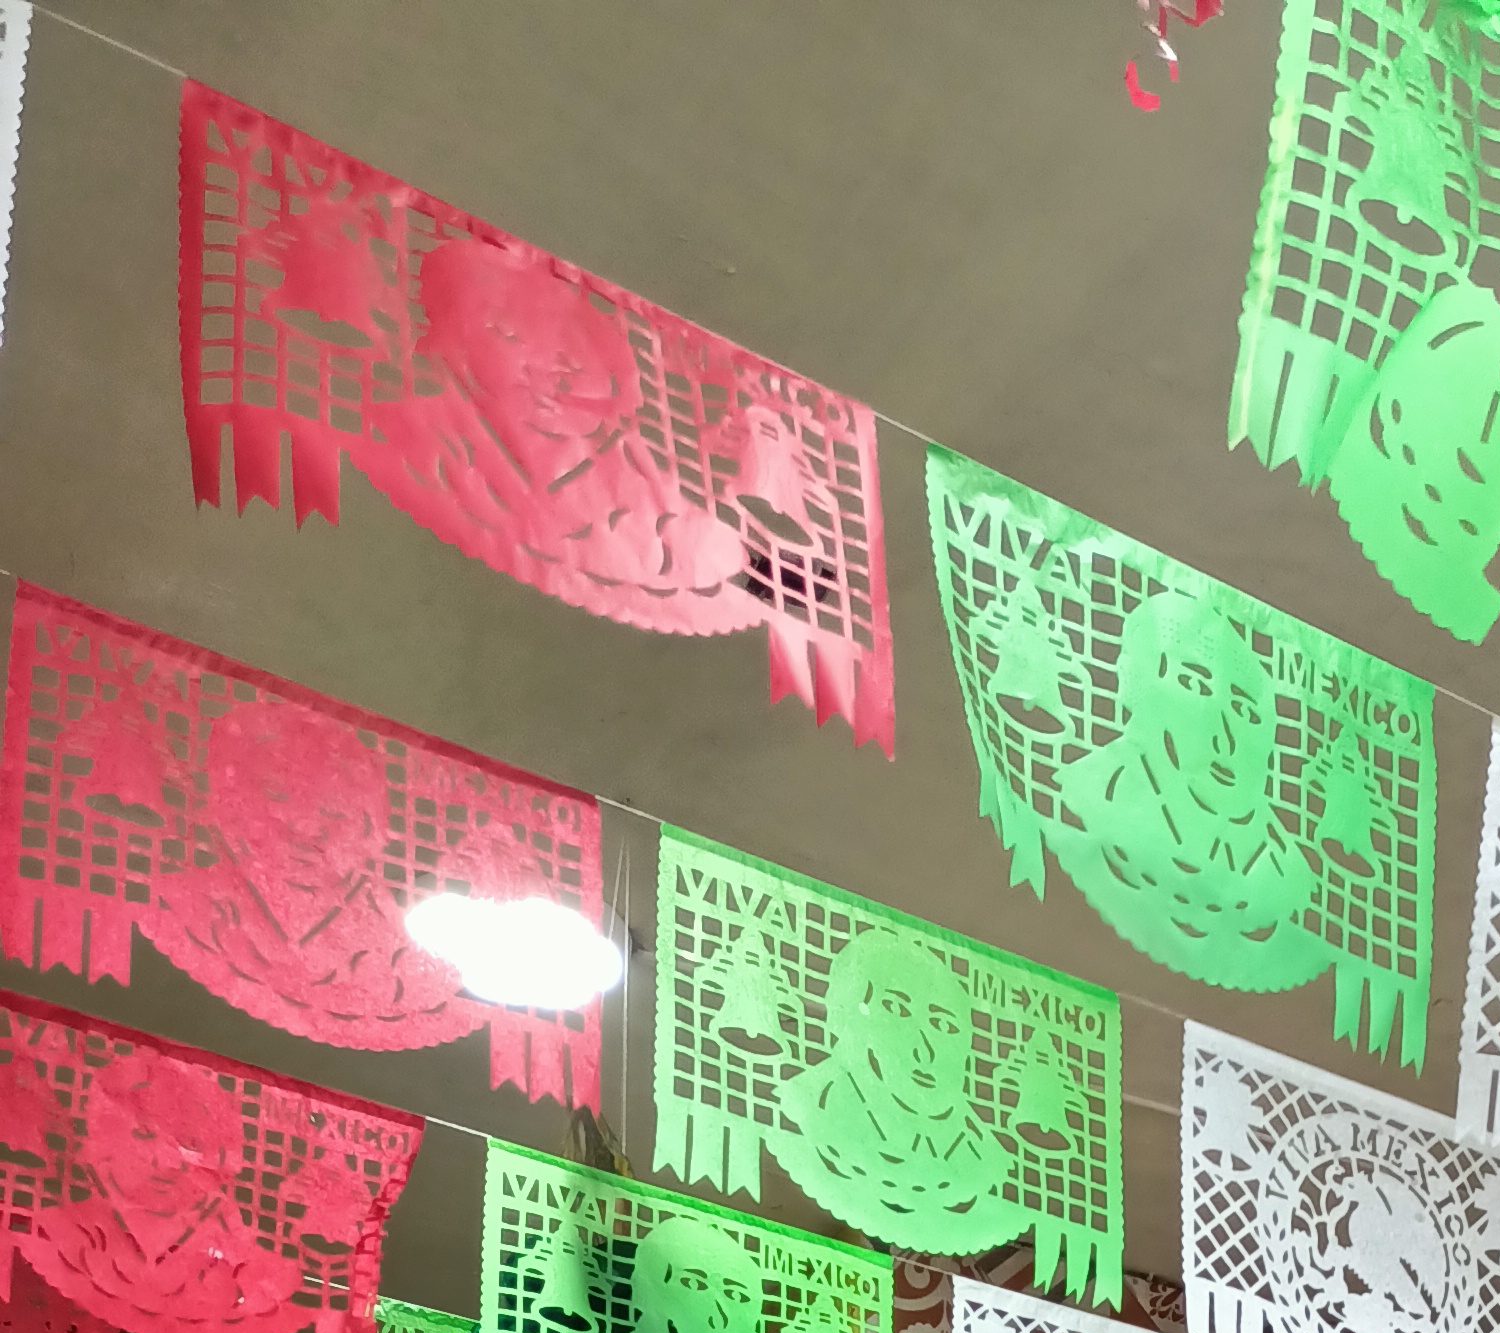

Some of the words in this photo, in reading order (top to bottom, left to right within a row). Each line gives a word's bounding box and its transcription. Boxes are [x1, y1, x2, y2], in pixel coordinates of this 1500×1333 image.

[942, 494, 1092, 600] VIVA
[1279, 648, 1418, 745] MEXICO
[676, 864, 797, 933] VIVA
[975, 969, 1104, 1040] MEXICO
[503, 1172, 607, 1226] VIVA
[765, 1245, 880, 1303] MEXICO
[1265, 1123, 1341, 1200] VIVA
[1351, 1121, 1471, 1267] MEXICO
